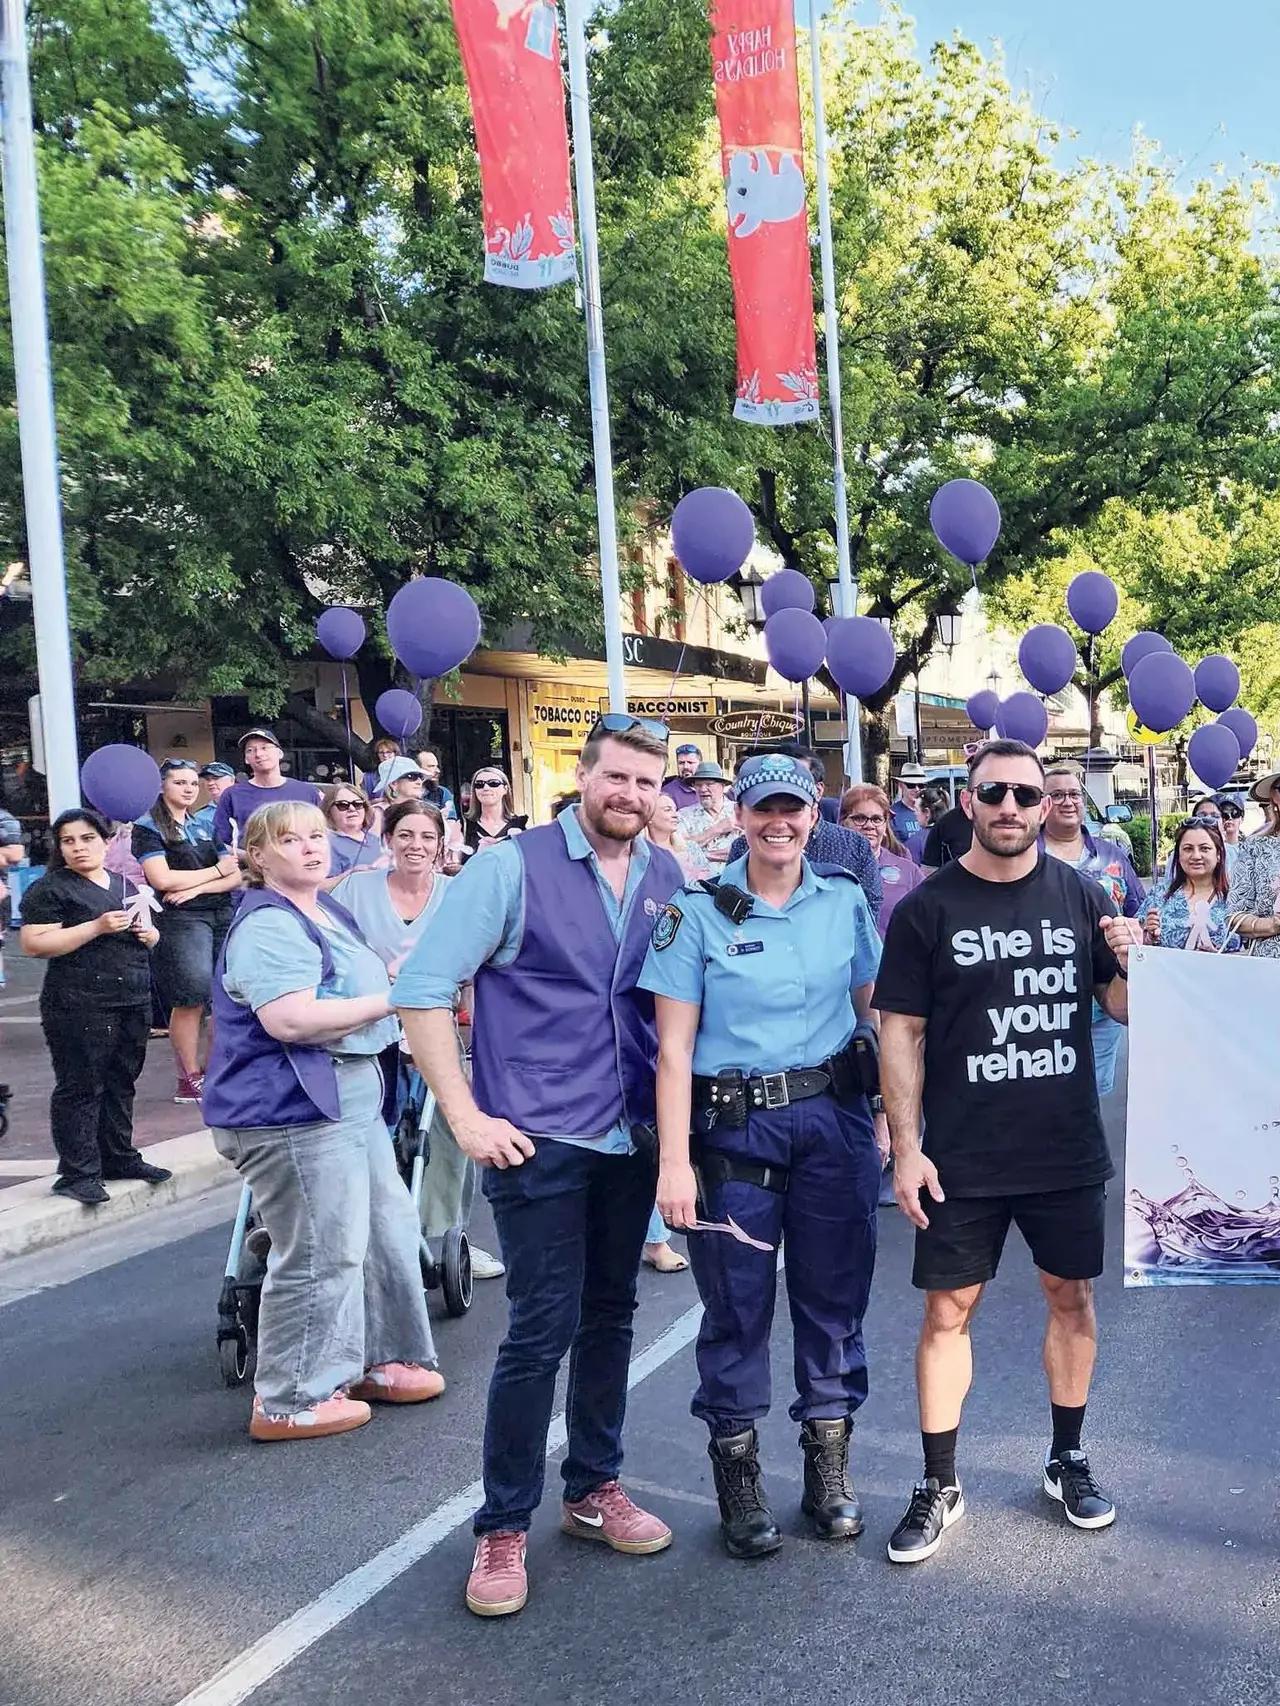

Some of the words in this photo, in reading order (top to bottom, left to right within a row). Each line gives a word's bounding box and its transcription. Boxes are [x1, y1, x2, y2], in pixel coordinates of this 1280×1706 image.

[623, 636, 644, 663] SC
[534, 705, 581, 724] TOBACCO
[627, 701, 709, 713] BACCONIST
[714, 714, 758, 733] Country
[951, 925, 1033, 966] She
[1040, 919, 1076, 955] is
[1013, 959, 1077, 997] not
[986, 1002, 1078, 1046] your
[966, 1038, 1077, 1083] rehab
